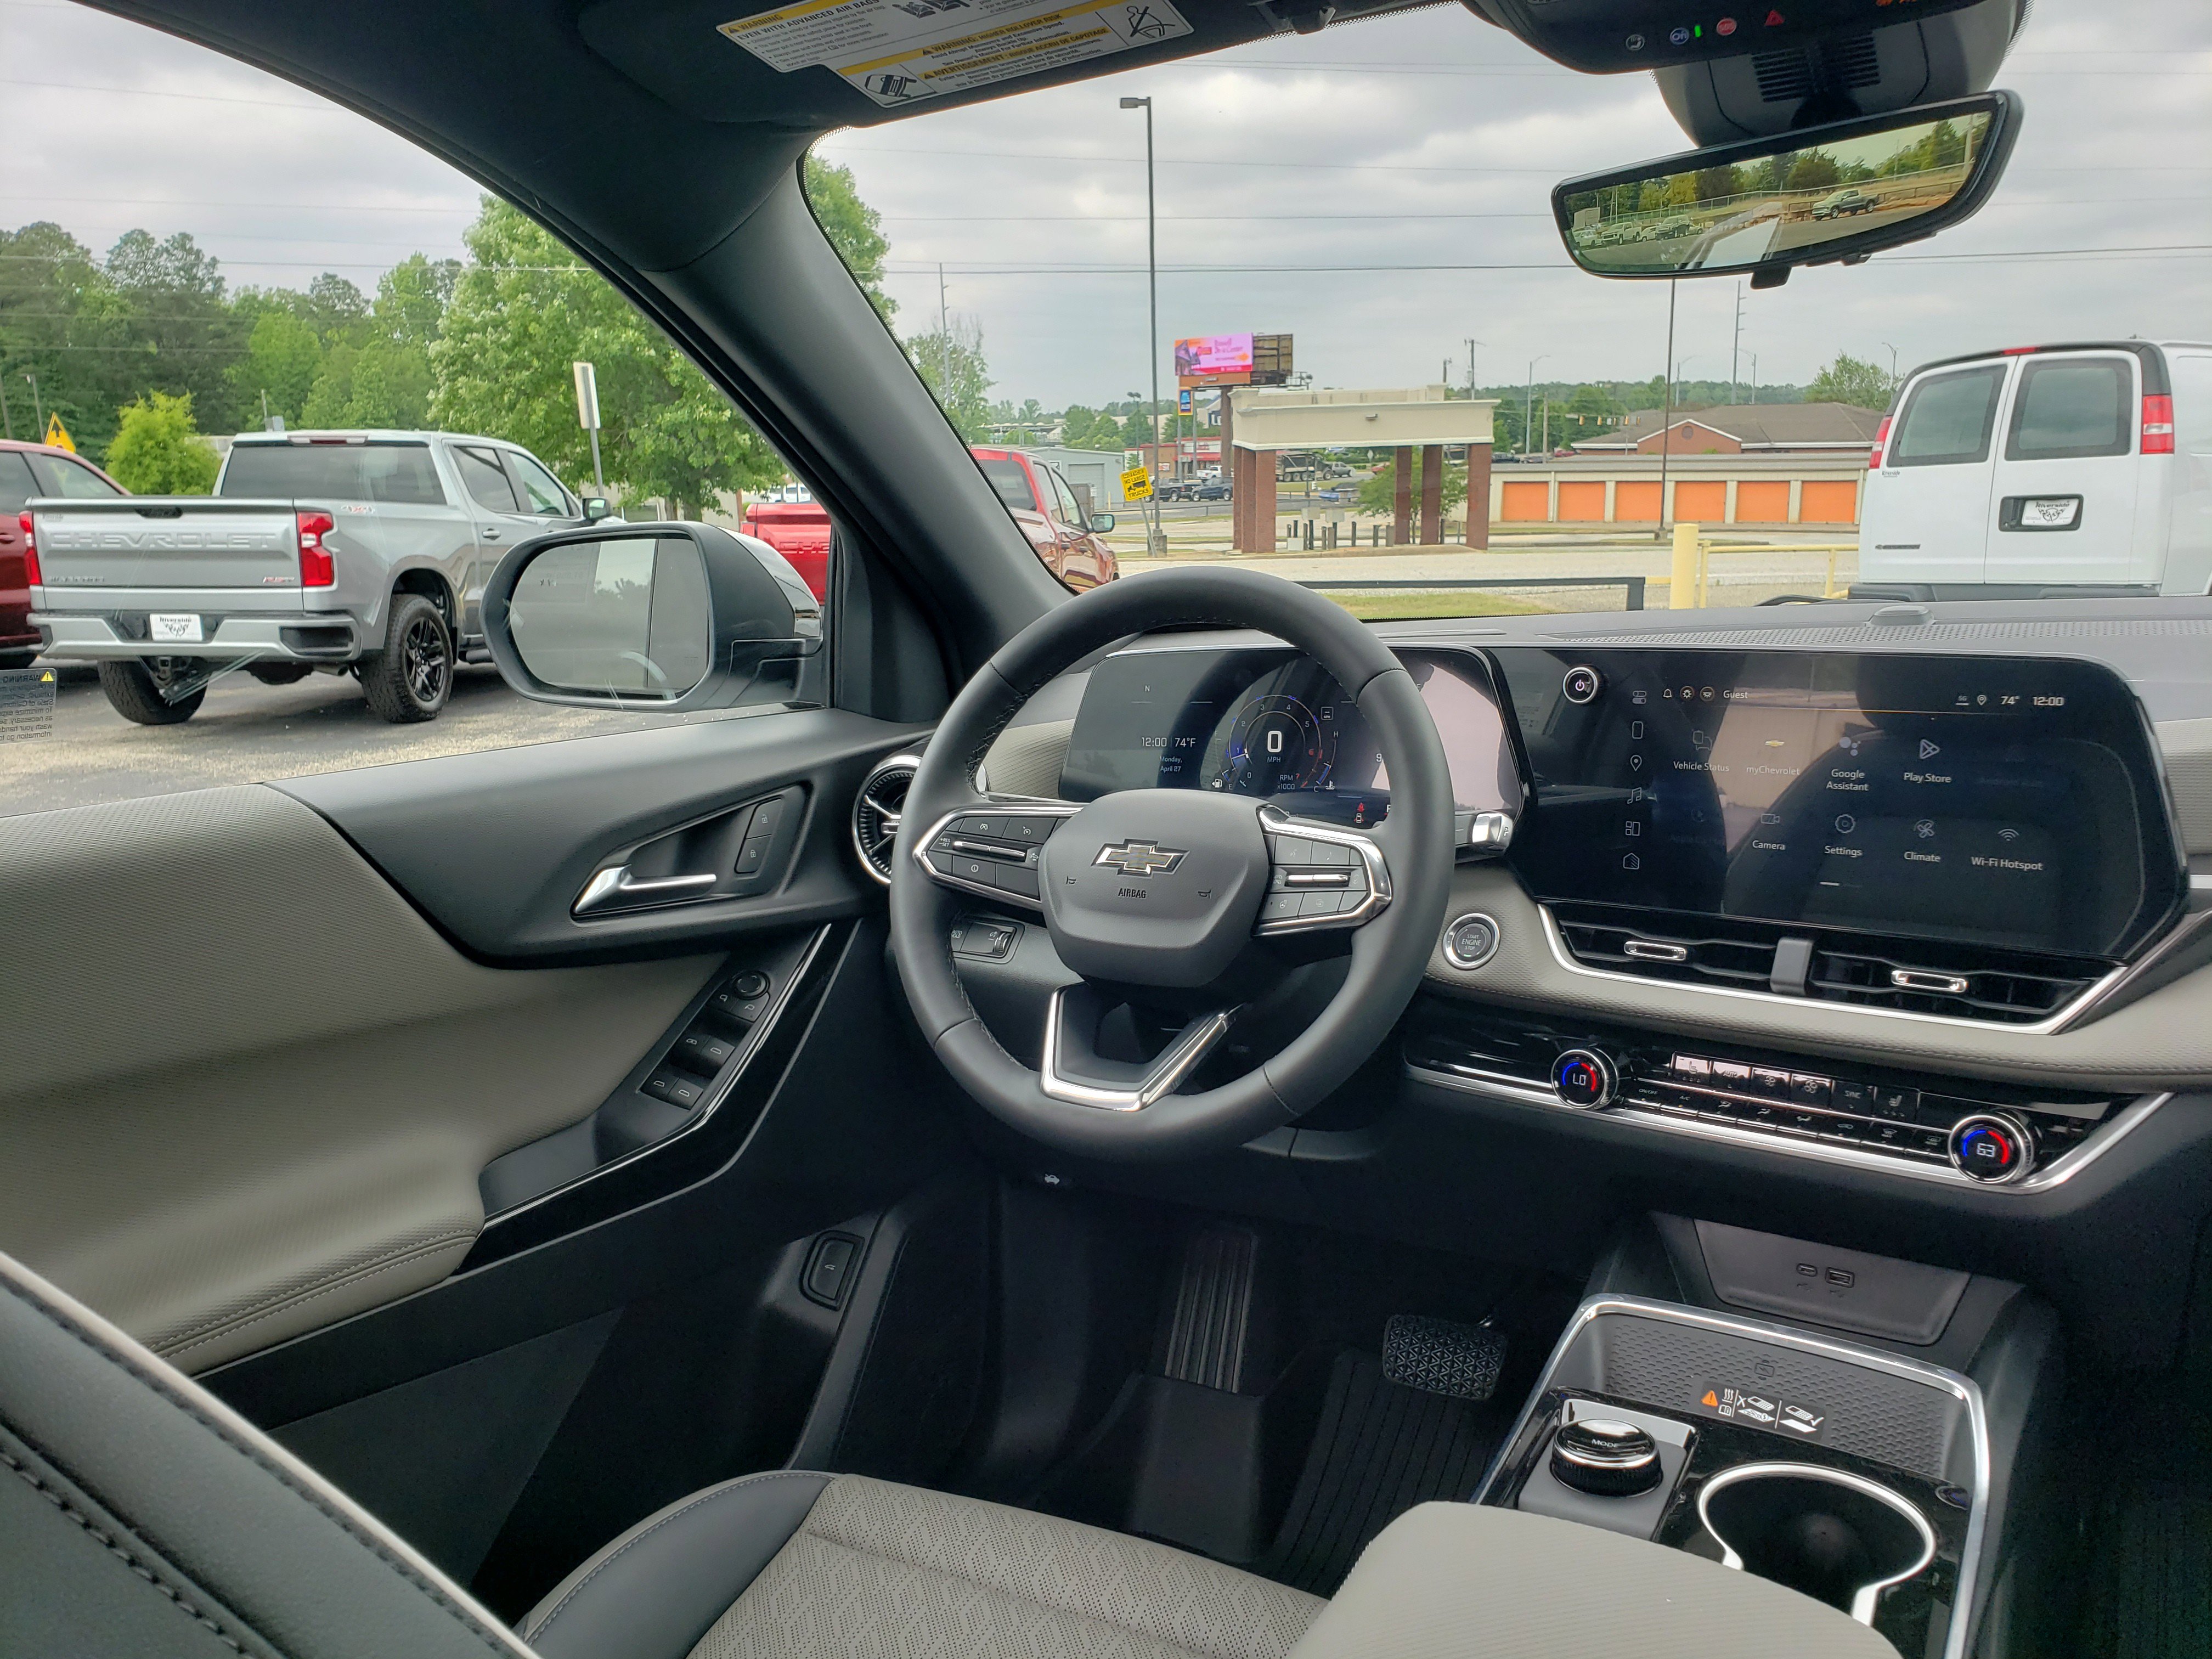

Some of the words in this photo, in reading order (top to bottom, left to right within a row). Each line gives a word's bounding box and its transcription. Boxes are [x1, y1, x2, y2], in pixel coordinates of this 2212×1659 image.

[737, 31, 761, 40] EVEN
[761, 24, 786, 33] WITH
[787, 10, 834, 27] ADVANCED
[836, 5, 853, 13] AIR
[738, 14, 783, 30] WARNING
[1006, 19, 1043, 32] ROLLOVER
[1043, 14, 1062, 22] RISK
[1131, 475, 1146, 483] LARGE
[1128, 488, 1149, 498] TRUCKS
[51, 532, 276, 548] CHEVROLET
[1723, 690, 1748, 699] Guest
[2000, 696, 2020, 705] 74°
[2033, 697, 2065, 706] 12:00
[1141, 737, 1167, 747] 12:00
[1175, 737, 1196, 747] 74°F
[1267, 730, 1282, 753] 0
[1673, 761, 1702, 770] Vehicle
[1704, 763, 1729, 771] Status
[1746, 765, 1800, 775] myChevrolet
[1831, 769, 1865, 780] Google
[1904, 772, 1923, 783] Play
[1925, 773, 1951, 783] Store
[1826, 781, 1869, 791] Assistant
[1752, 840, 1785, 850] Camera
[1824, 845, 1863, 858] Settings
[1904, 851, 1941, 862] Climate
[1971, 856, 1998, 867] Wi-Fi
[2000, 859, 2043, 871] Hotspot
[1118, 888, 1147, 899] AIRBAG
[1572, 1073, 1587, 1086] LO
[1844, 1090, 1861, 1099] SYNC
[1592, 1438, 1618, 1448] MODE
